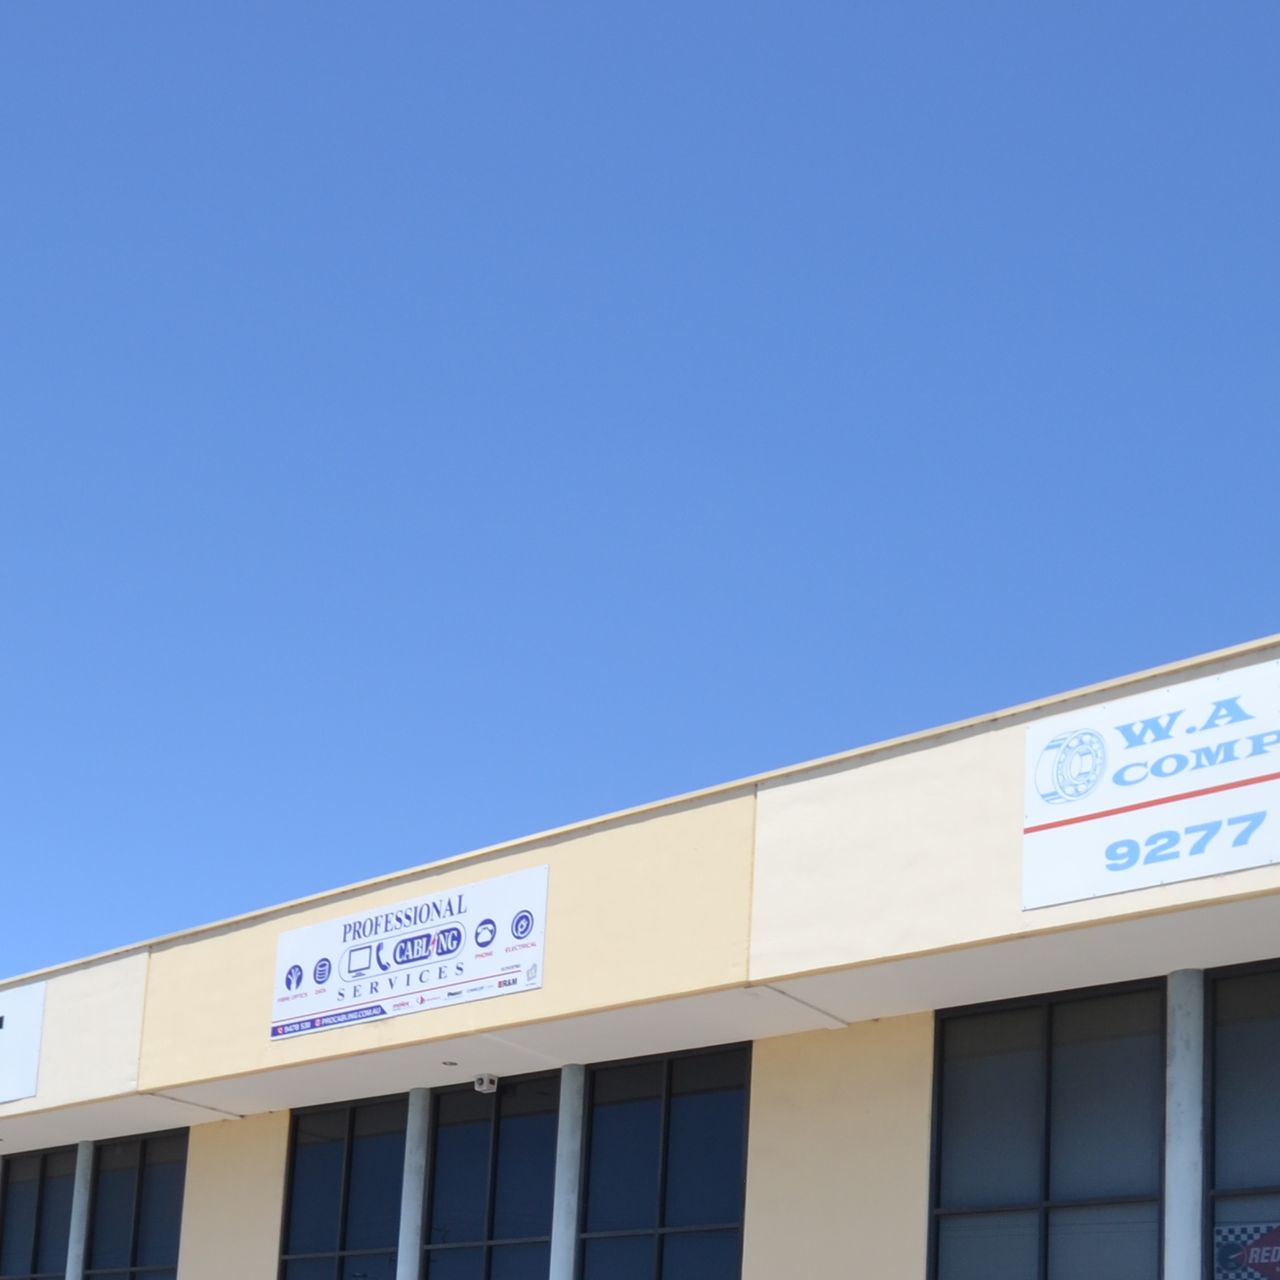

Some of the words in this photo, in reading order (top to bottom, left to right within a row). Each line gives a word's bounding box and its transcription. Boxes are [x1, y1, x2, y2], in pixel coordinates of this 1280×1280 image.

[1114, 695, 1255, 750] W.A
[1104, 810, 1268, 872] 9277
[341, 893, 468, 943] PROFESSIONAL
[336, 961, 465, 1002] SERVICES
